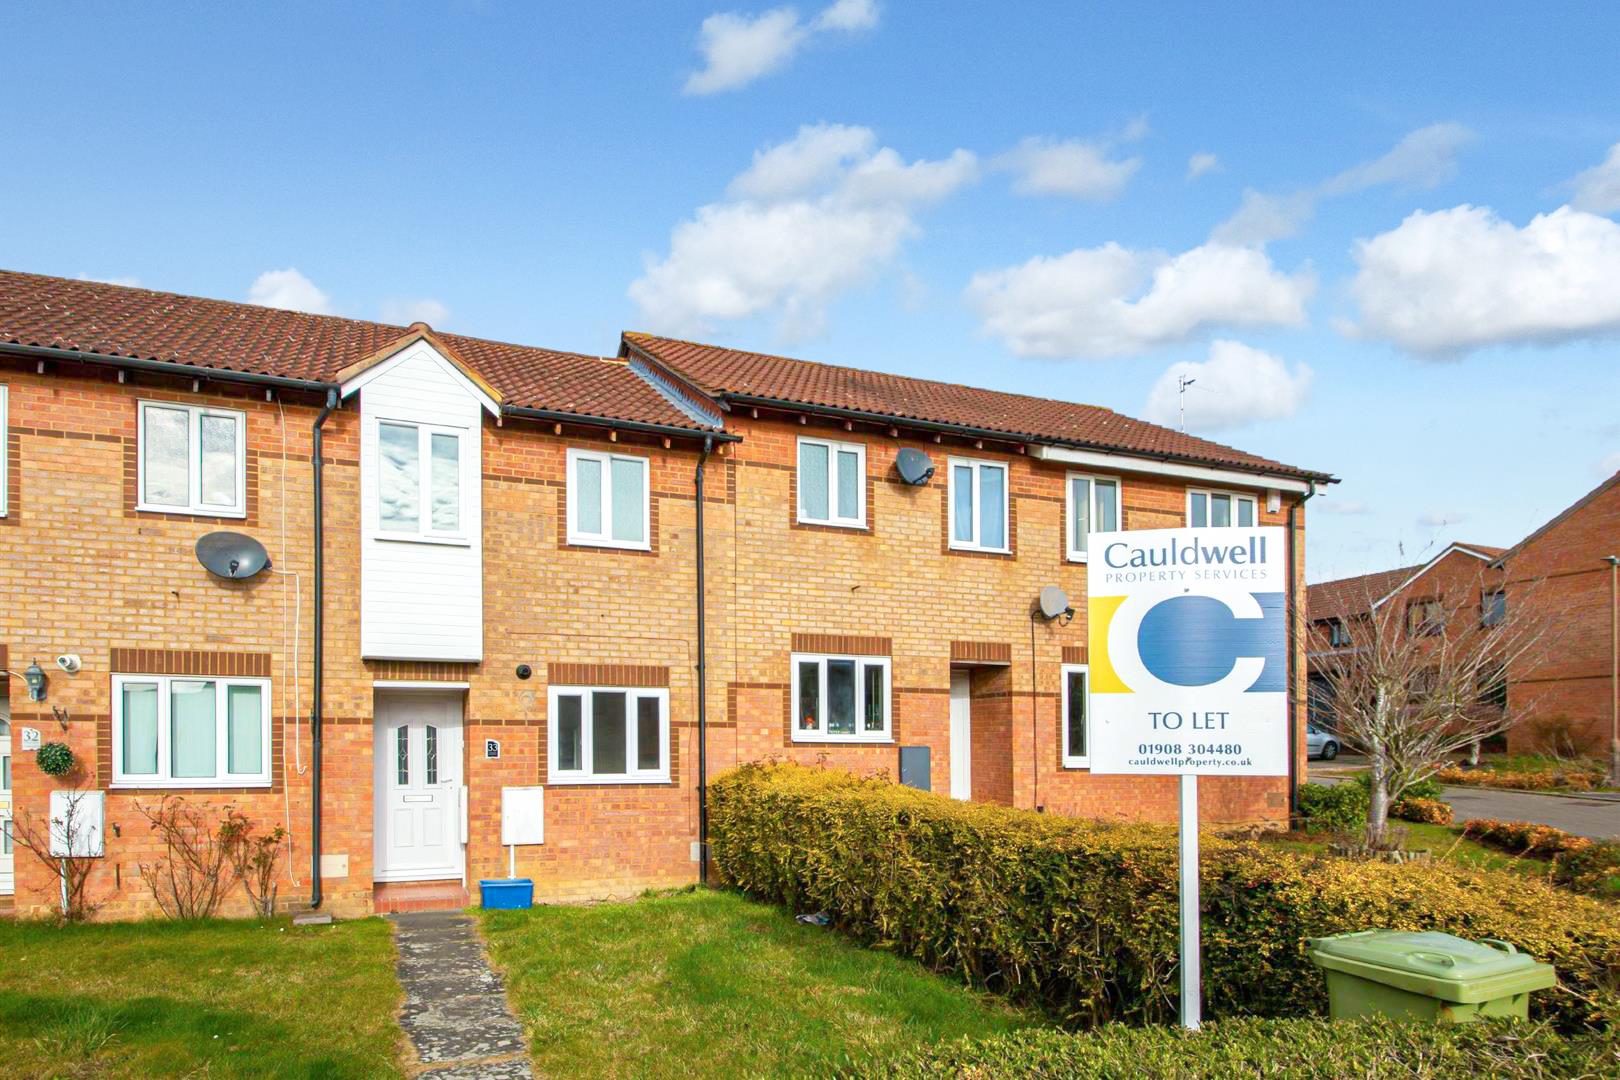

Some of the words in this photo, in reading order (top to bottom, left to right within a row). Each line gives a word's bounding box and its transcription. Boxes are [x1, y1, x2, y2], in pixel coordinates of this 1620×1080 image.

[1104, 536, 1266, 568] Cauldwell
[1105, 570, 1186, 583] PROPERTY
[1195, 568, 1267, 580] SERVICES
[1147, 711, 1183, 730] TO
[1192, 711, 1230, 730] LET
[23, 730, 39, 742] 32
[487, 743, 498, 752] 33
[1138, 744, 1182, 755] 01908
[1188, 744, 1242, 755] 304480
[1128, 757, 1253, 768] cauldwellproperty.co.uk
